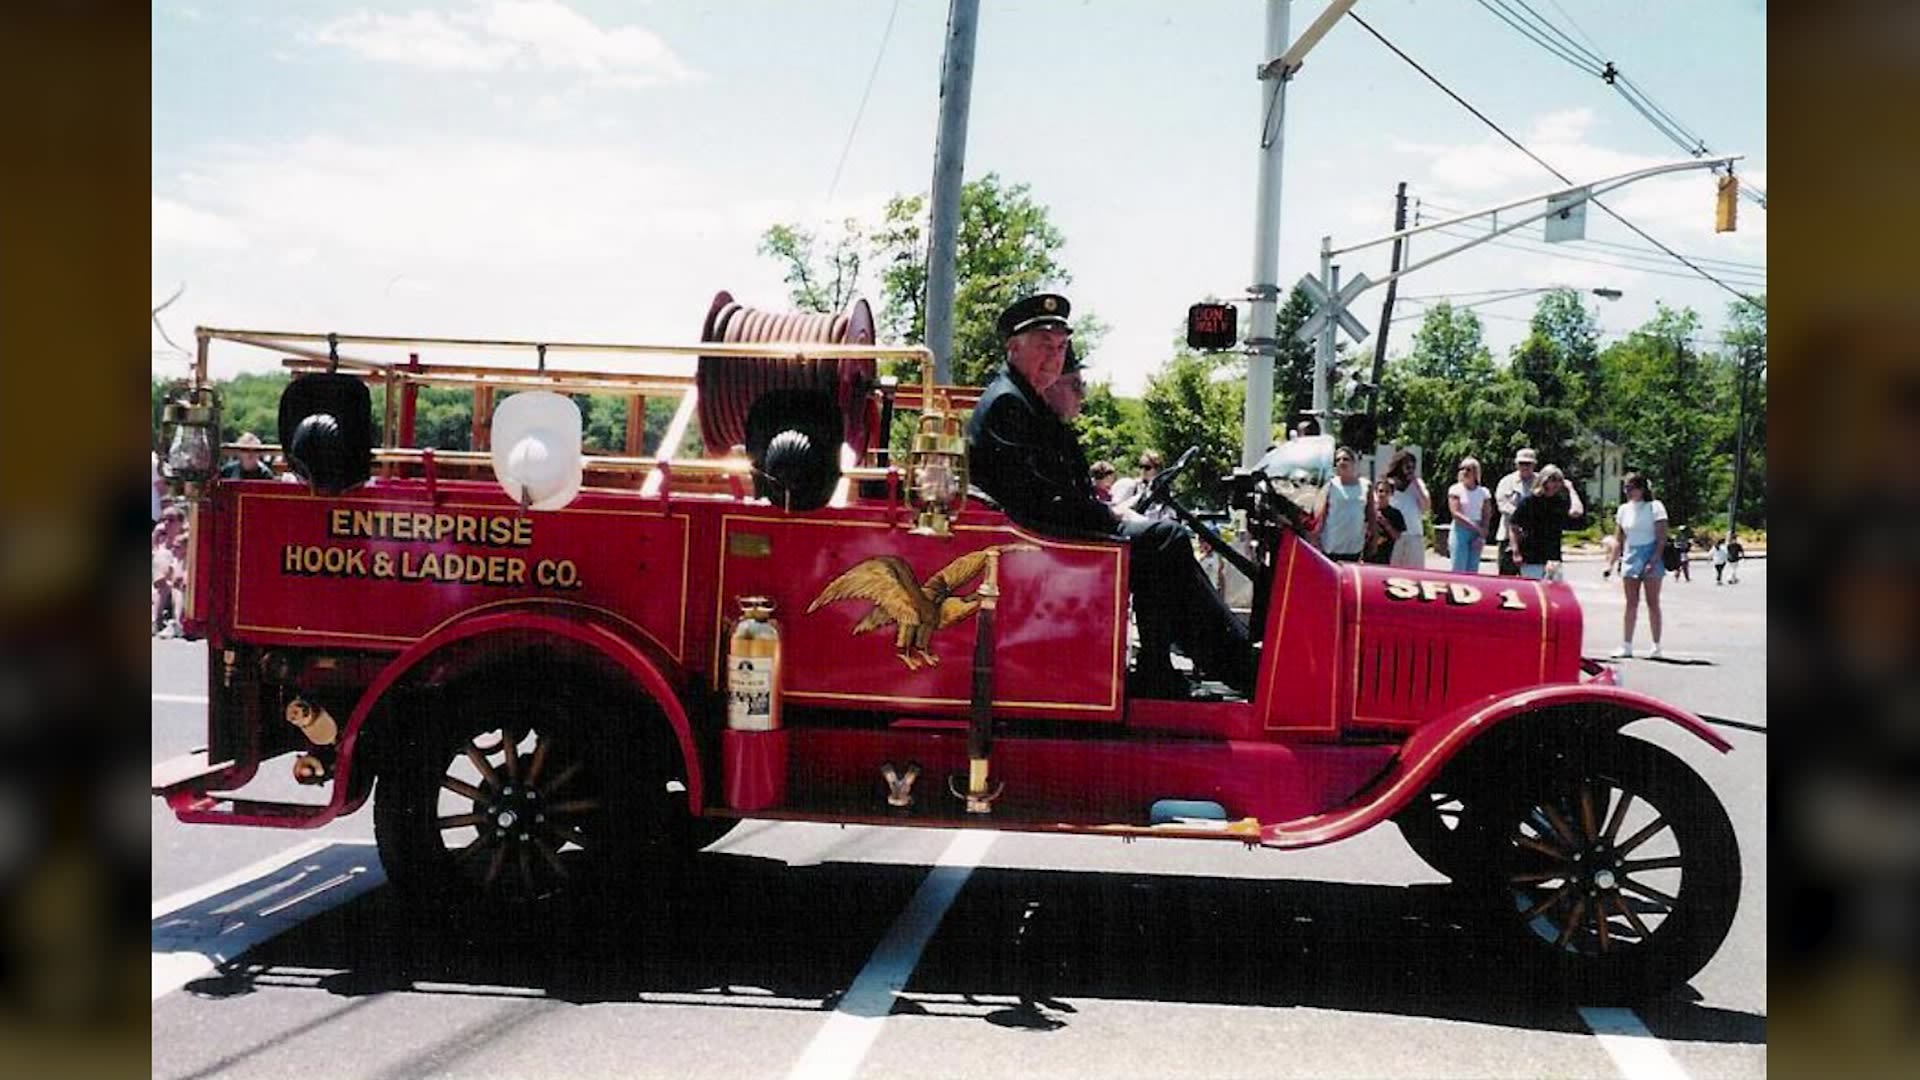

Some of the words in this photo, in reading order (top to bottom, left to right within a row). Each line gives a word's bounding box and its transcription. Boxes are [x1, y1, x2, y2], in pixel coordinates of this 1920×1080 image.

[331, 508, 534, 545] ENTERPRISE
[284, 544, 368, 576] HOOK
[373, 552, 396, 578] &
[401, 551, 527, 585] LADDER
[536, 558, 583, 588] CO.
[1385, 577, 1483, 604] SFD
[1499, 588, 1527, 610] 1
